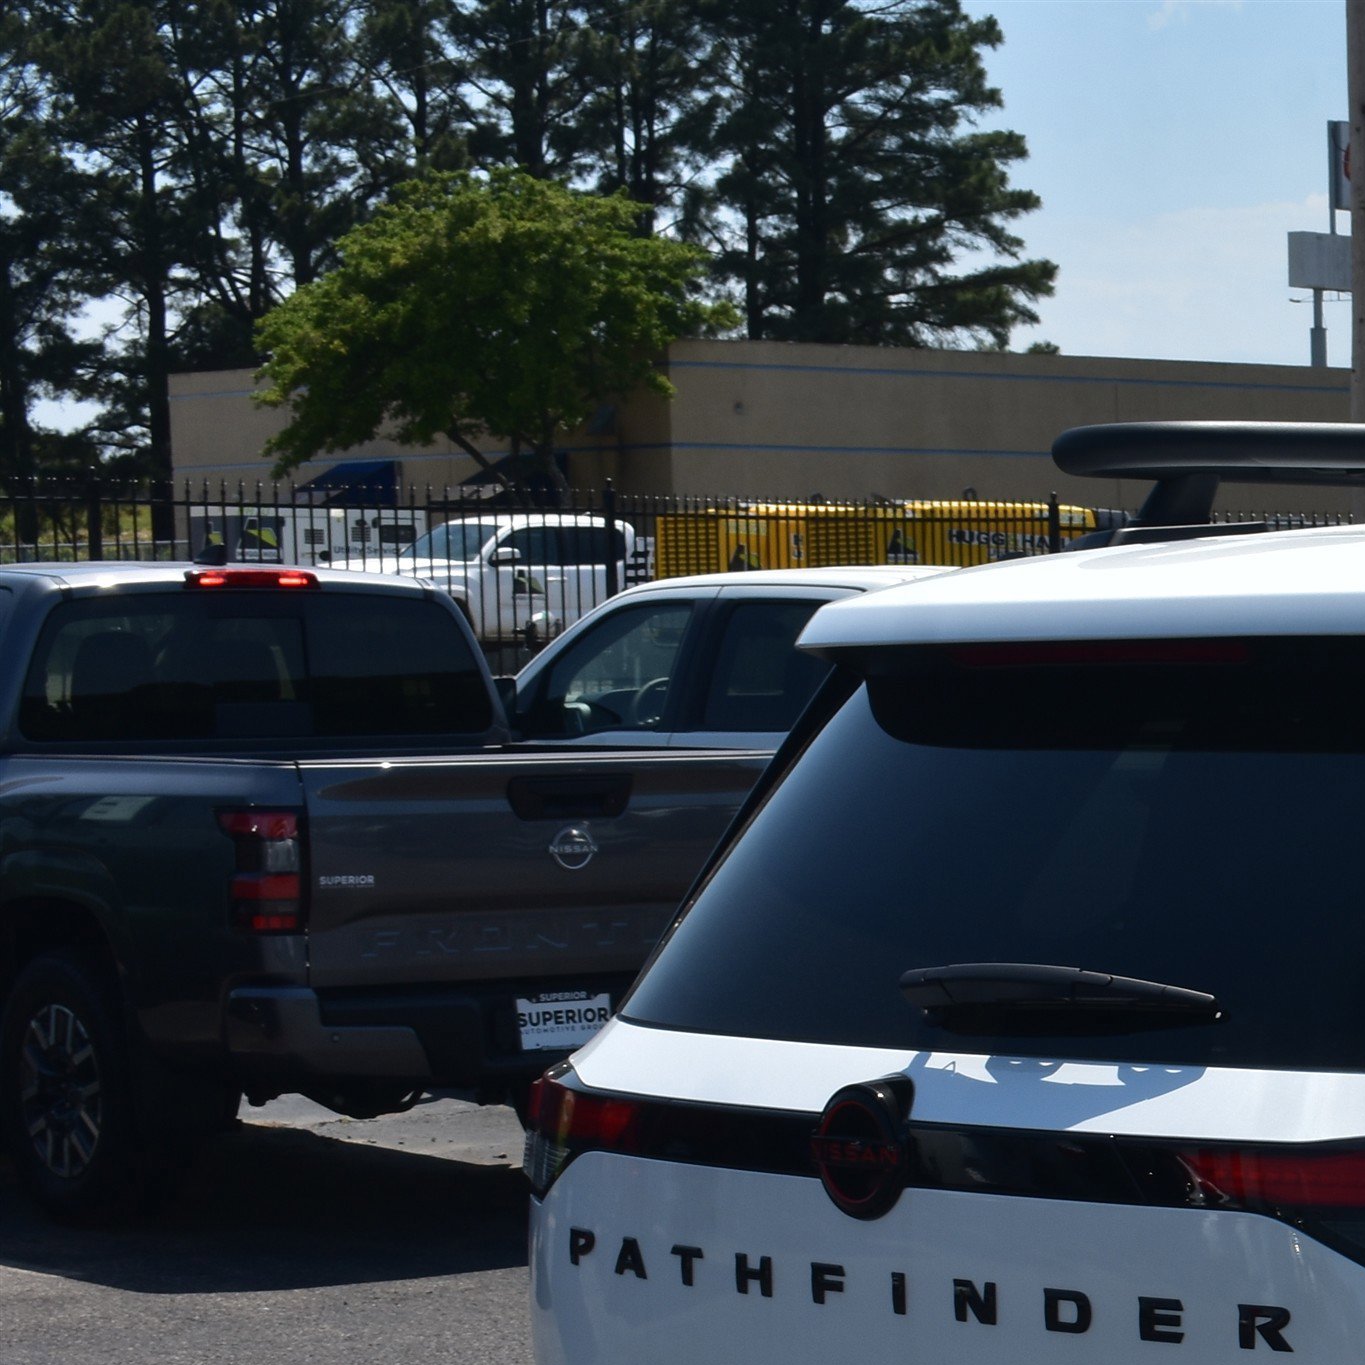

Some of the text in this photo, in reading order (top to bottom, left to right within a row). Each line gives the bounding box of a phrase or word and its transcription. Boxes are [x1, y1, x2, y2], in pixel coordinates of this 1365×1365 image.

[548, 845, 599, 854] NISSAN
[319, 875, 375, 885] SUPERIOR
[539, 991, 587, 1002] SUPERIOR
[518, 1007, 609, 1027] SUPERIOR
[811, 1139, 898, 1165] NISSAN
[569, 1227, 1294, 1352] PATHFINDER
